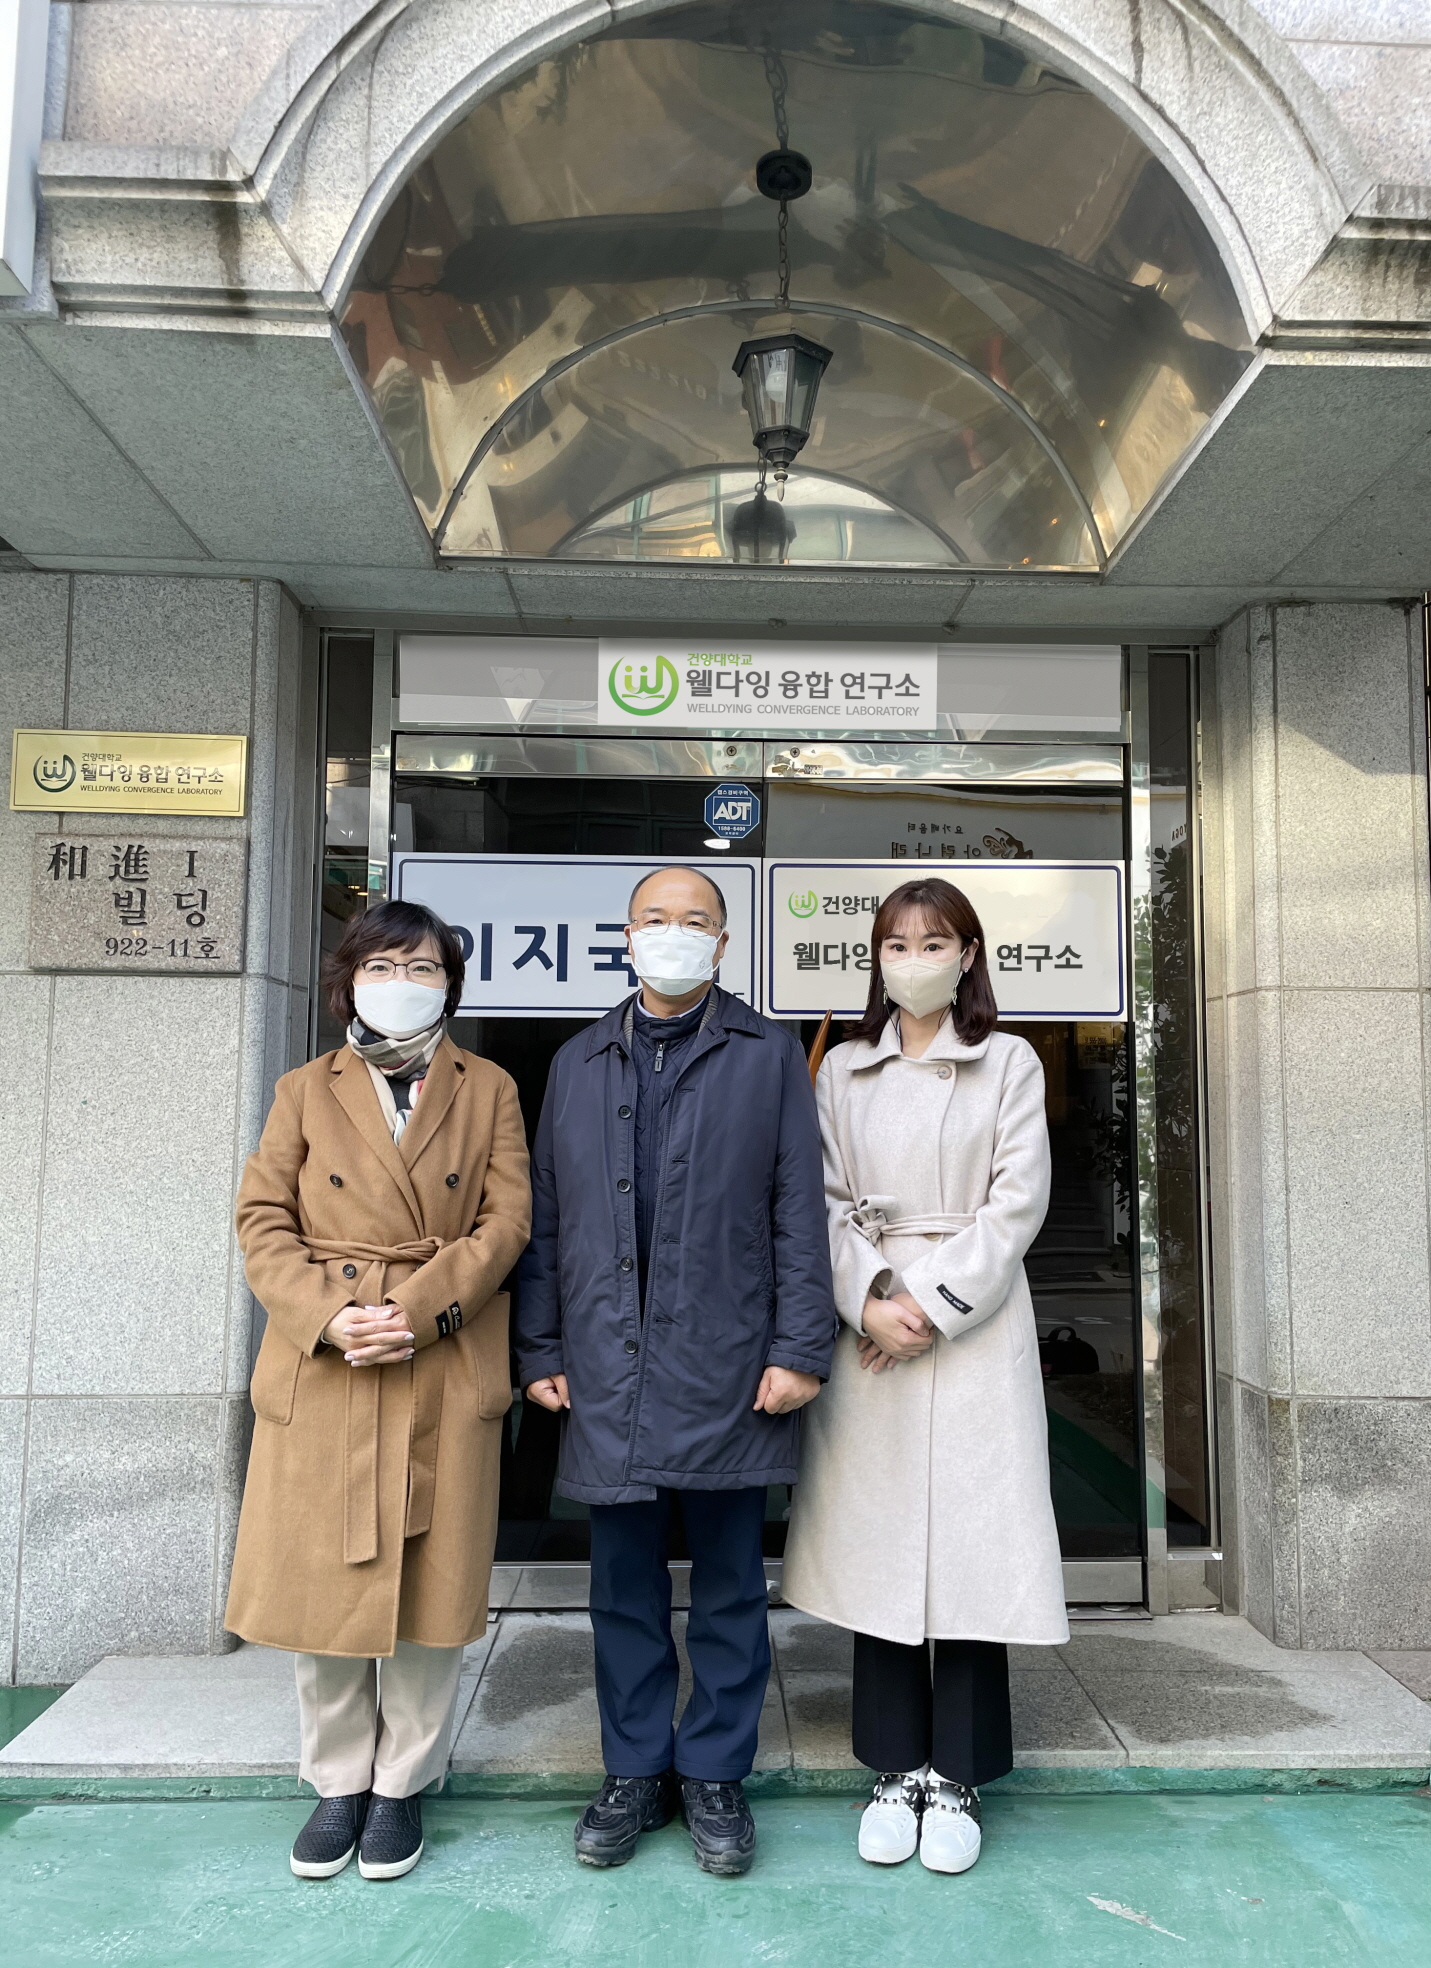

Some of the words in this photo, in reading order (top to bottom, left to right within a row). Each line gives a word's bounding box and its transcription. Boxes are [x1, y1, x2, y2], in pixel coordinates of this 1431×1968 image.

[687, 653, 753, 666] 건양대학교
[686, 669, 771, 699] 웰다잉
[778, 671, 834, 700] 융합
[839, 672, 921, 700] 연구소
[687, 703, 753, 714] WELLDYING
[757, 704, 841, 716] CONVERGENCE
[846, 705, 920, 717] LABORATORY
[82, 752, 122, 762] 건양대학교
[80, 763, 133, 783] 웰다잉
[137, 764, 172, 784] 융합
[175, 766, 224, 784] 연구소
[80, 785, 121, 793] WELLDYING
[123, 786, 175, 794] CONVERGENCE
[178, 787, 223, 796] LABORATORY
[713, 802, 752, 820] ADT
[112, 888, 208, 928] 빌딩
[105, 936, 221, 959] 922-11호
[449, 923, 719, 986] 이지국
[997, 943, 1083, 972] 연구소
